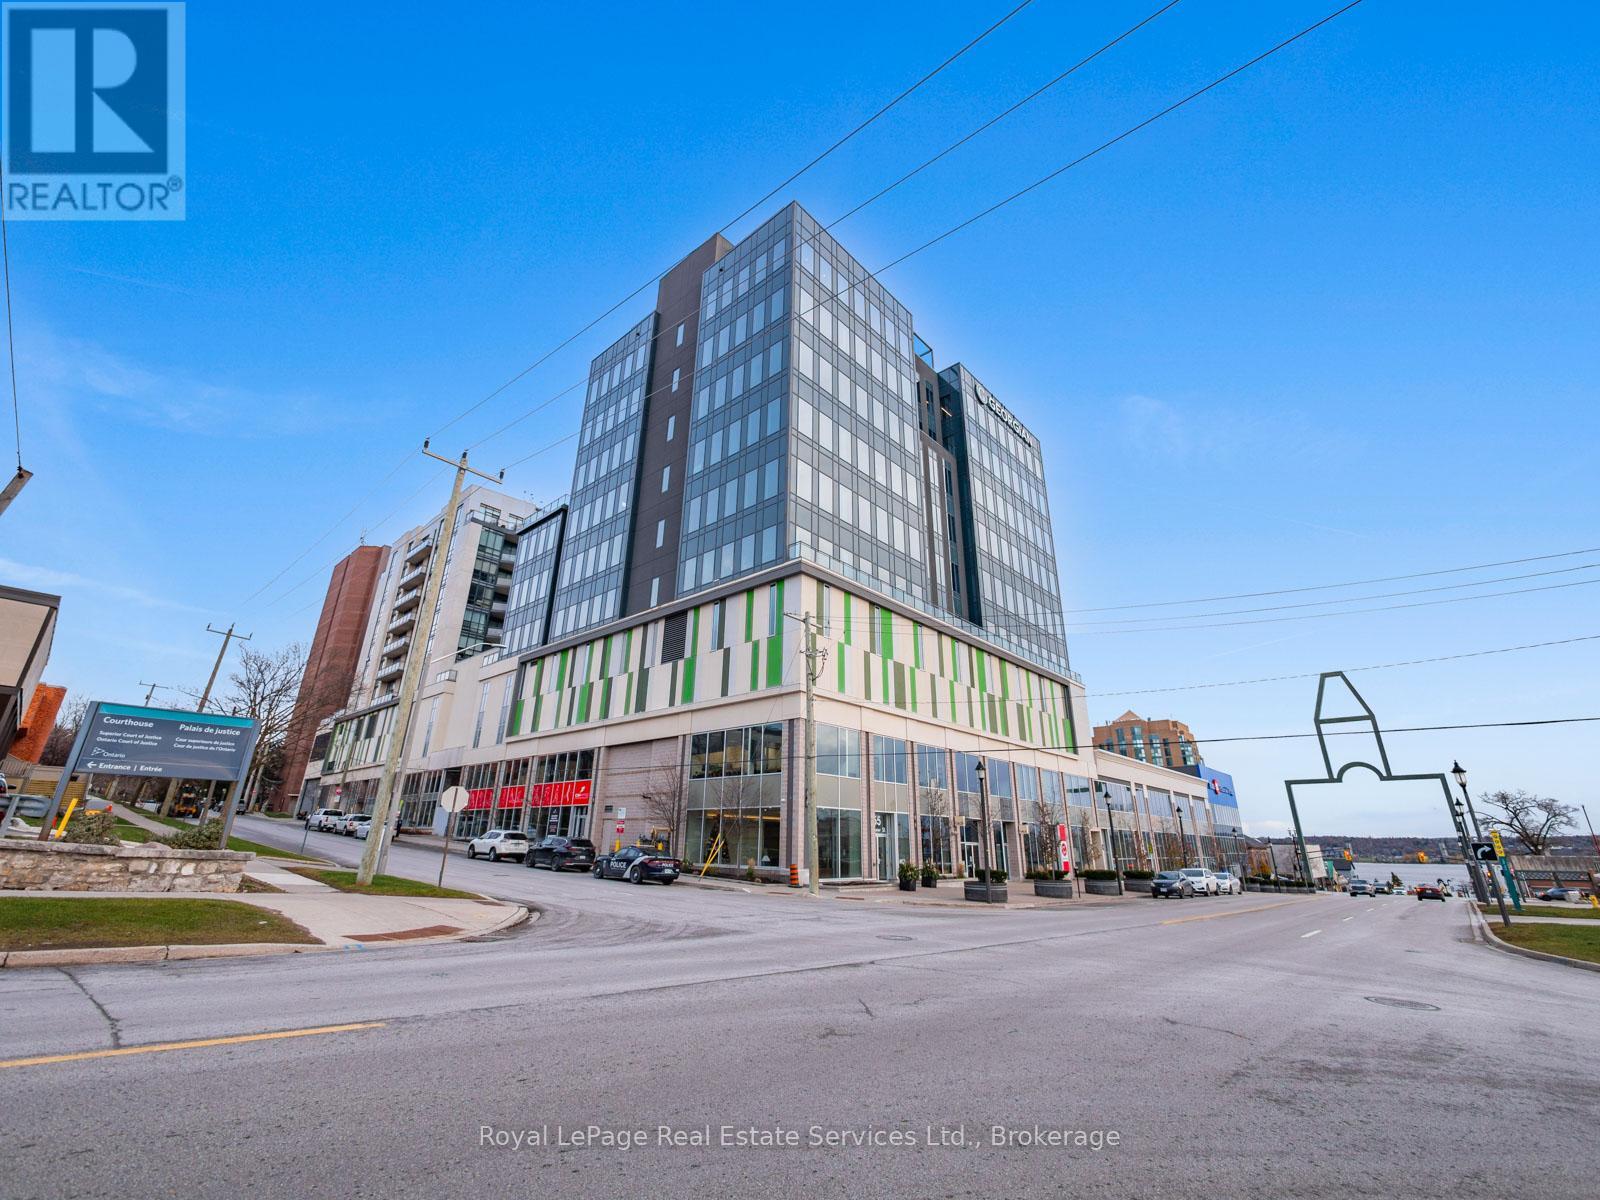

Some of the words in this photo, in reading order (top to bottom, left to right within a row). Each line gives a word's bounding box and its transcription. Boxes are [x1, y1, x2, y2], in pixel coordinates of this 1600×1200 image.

[103, 716, 154, 728] Courthouse
[179, 723, 203, 733] Palais
[214, 727, 241, 736] justice
[98, 762, 132, 771] Entrance
[610, 861, 627, 869] POLICE
